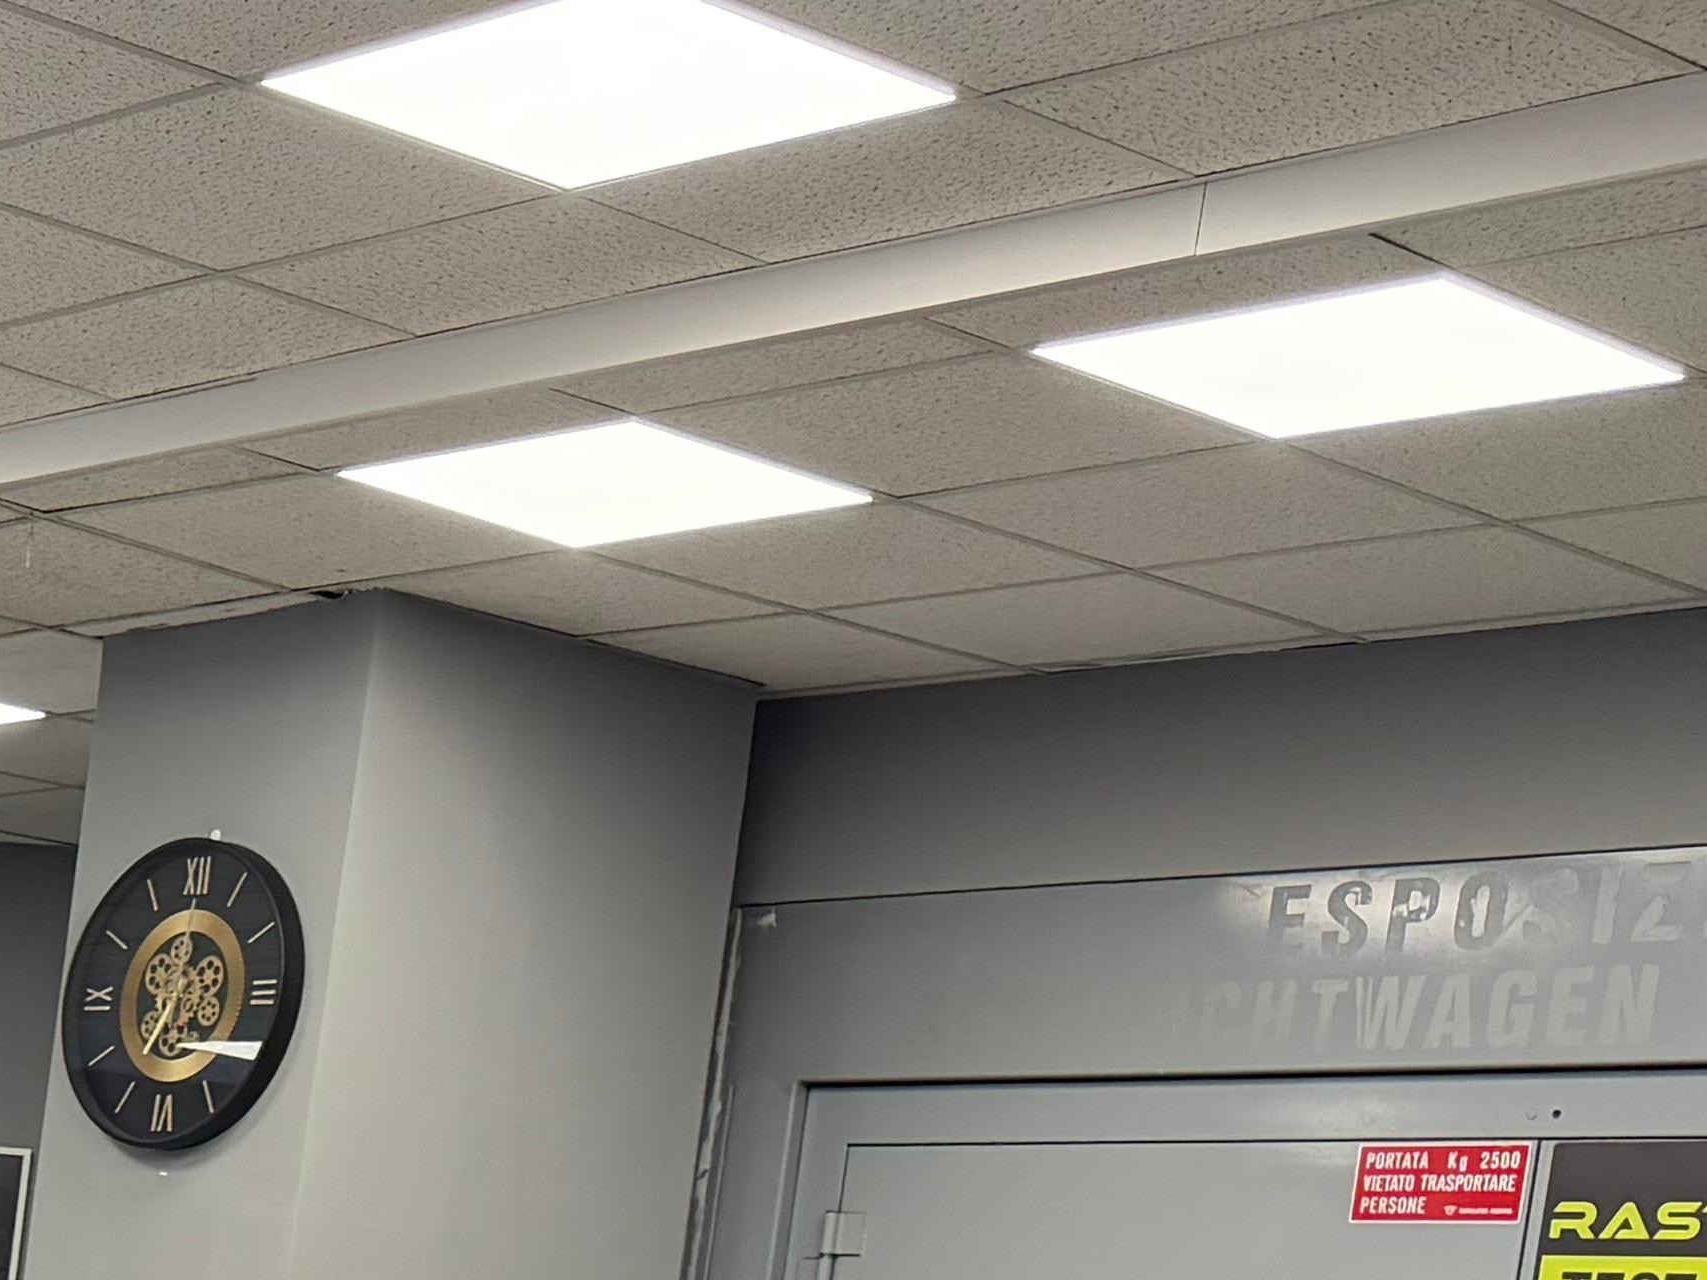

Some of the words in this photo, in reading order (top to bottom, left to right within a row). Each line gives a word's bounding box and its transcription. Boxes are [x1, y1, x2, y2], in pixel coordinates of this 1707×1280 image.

[1365, 1151, 1429, 1170] PORTATA
[1447, 1151, 1468, 1172] Kg
[1480, 1151, 1521, 1170] 2500
[1363, 1175, 1415, 1192] VIETATO
[1420, 1174, 1518, 1193] TRASPORTARE
[1360, 1196, 1427, 1215] PERSONE
[1549, 1201, 1707, 1240] RAS
